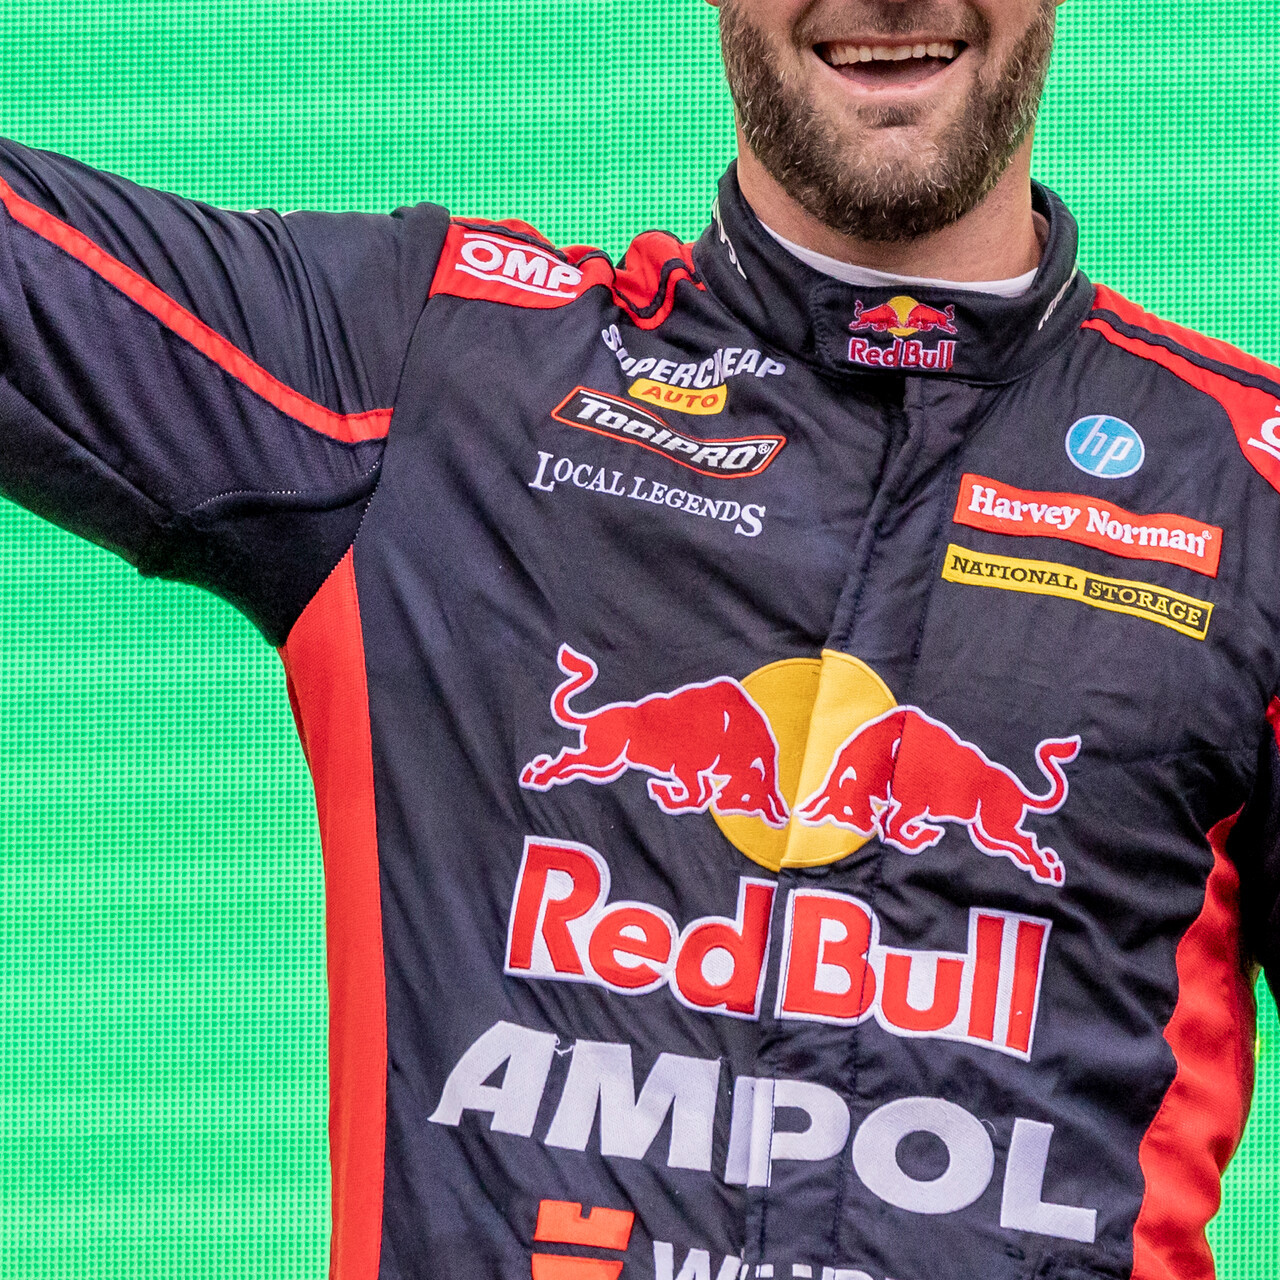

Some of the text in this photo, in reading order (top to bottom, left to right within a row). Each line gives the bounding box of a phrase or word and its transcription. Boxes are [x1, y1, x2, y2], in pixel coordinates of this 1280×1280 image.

[460, 240, 582, 289] OMP
[601, 324, 787, 389] SUPERCHEAP
[848, 337, 957, 372] Red Bull
[641, 385, 719, 409] AUTO
[1077, 417, 1135, 477] hp
[528, 451, 767, 537] LOCAL LEGENDS
[968, 484, 1081, 530] Harvey
[950, 555, 1202, 626] NATIONAL STORAGE
[504, 835, 1053, 1062] Red Bull
[427, 1019, 1097, 1244] AMPOL
